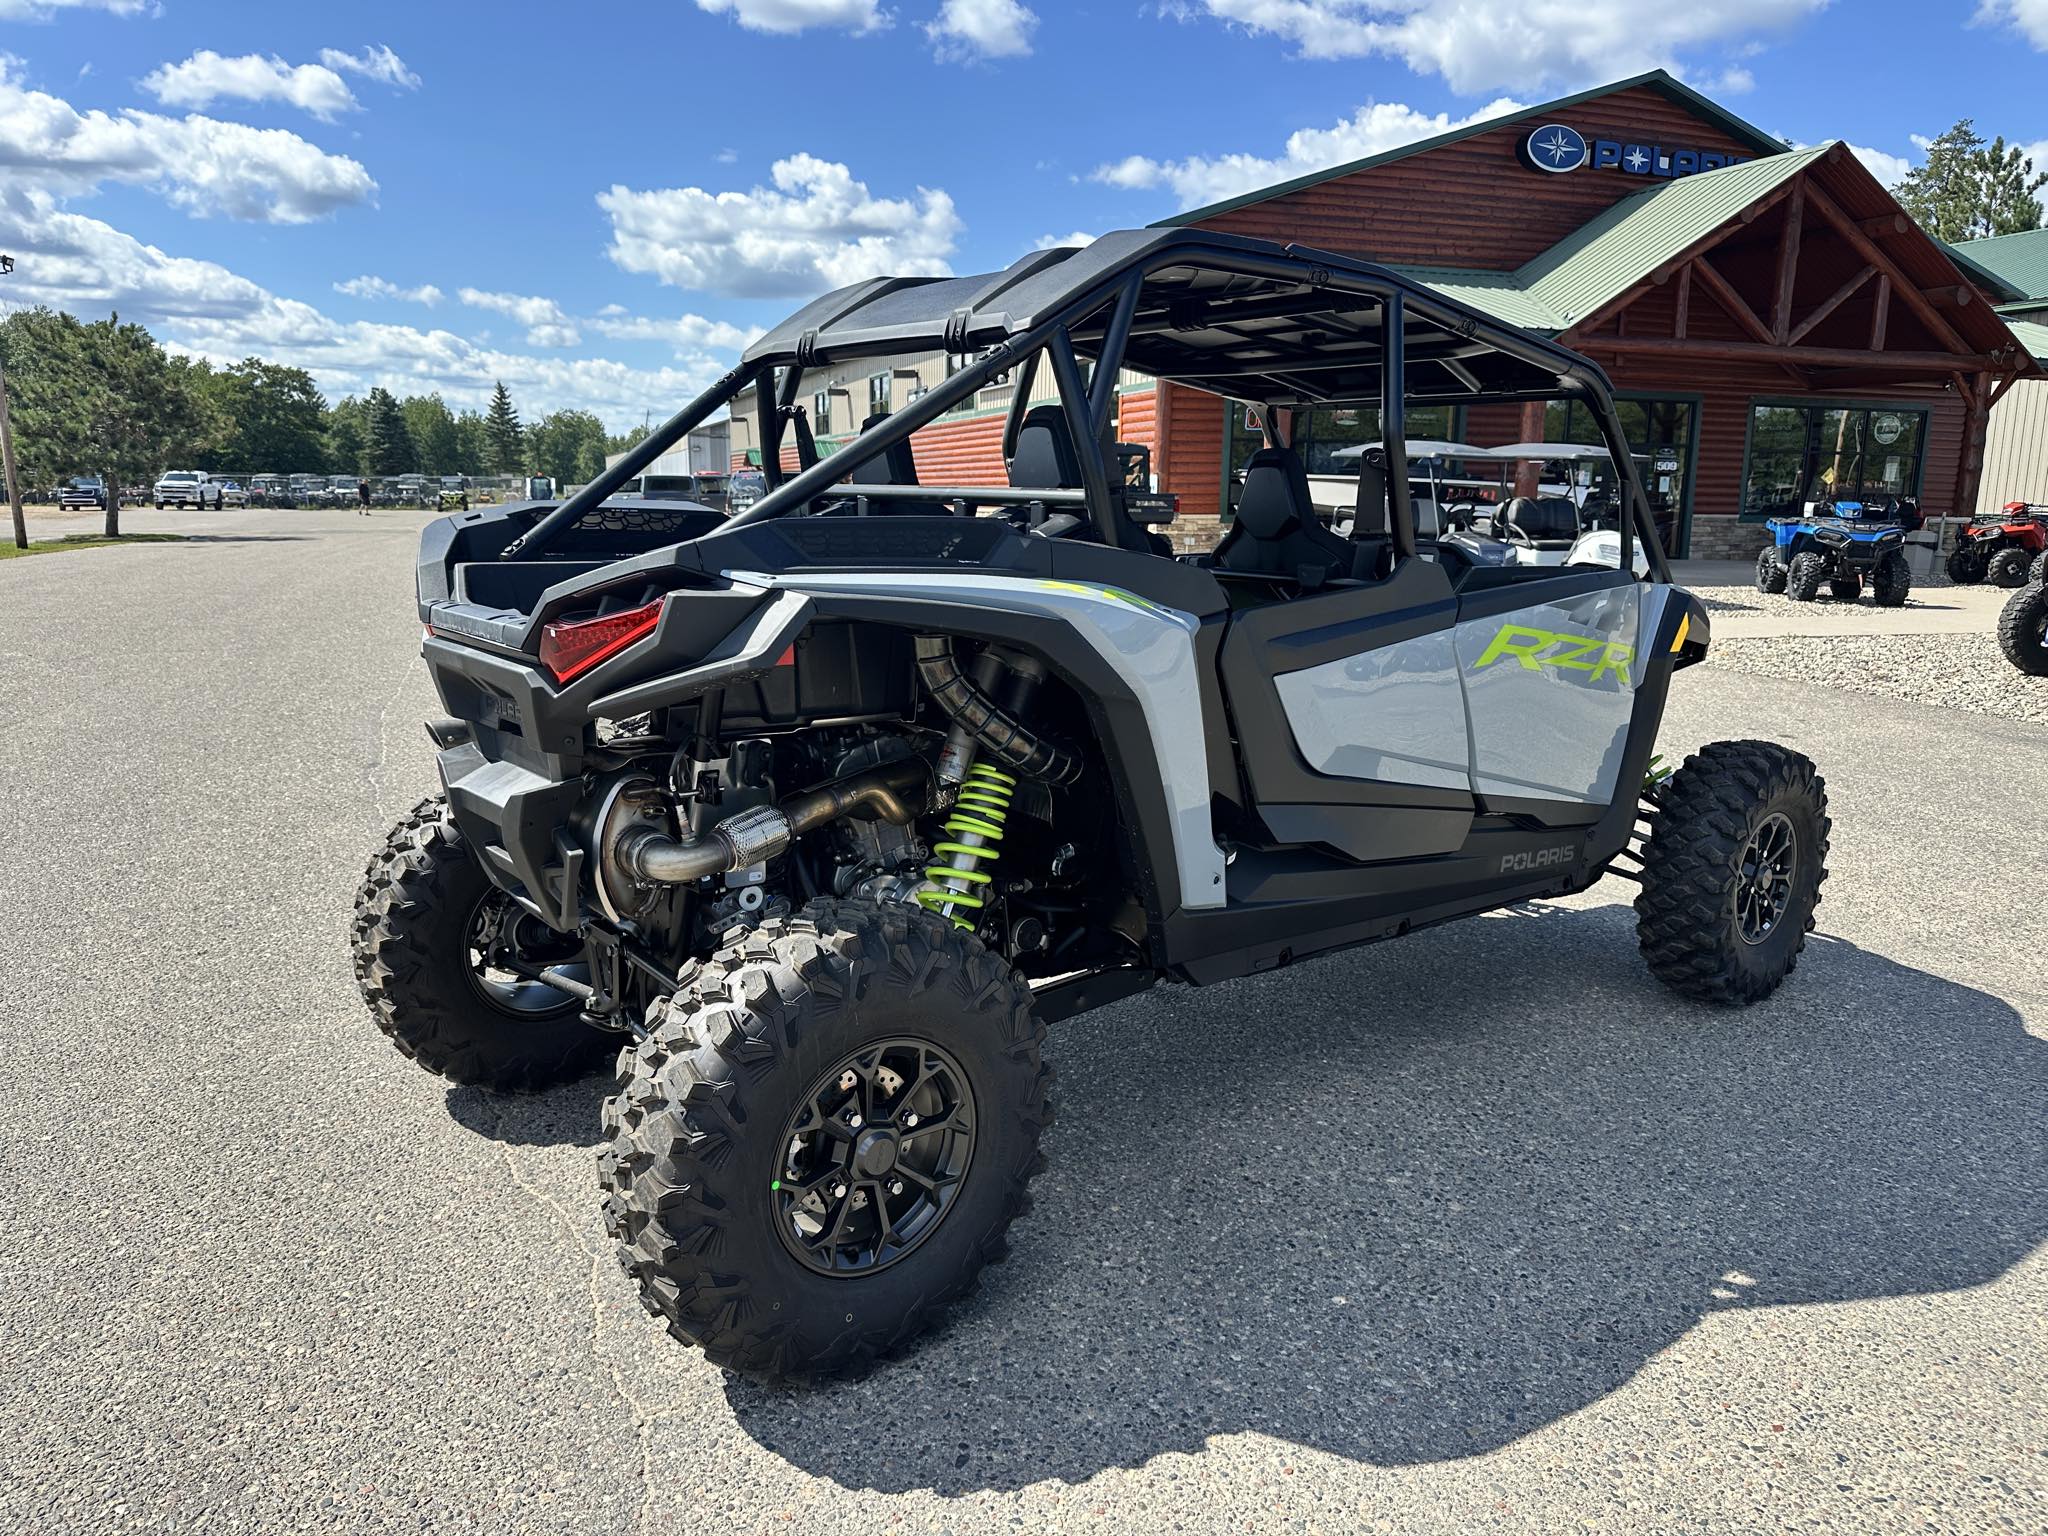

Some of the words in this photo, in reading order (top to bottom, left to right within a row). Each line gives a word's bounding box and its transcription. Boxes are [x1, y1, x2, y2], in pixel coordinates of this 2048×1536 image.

[1595, 138, 1753, 178] POLAR
[1656, 461, 1678, 471] 509
[1473, 624, 1635, 685] RZR
[1500, 845, 1575, 873] POLARIS
